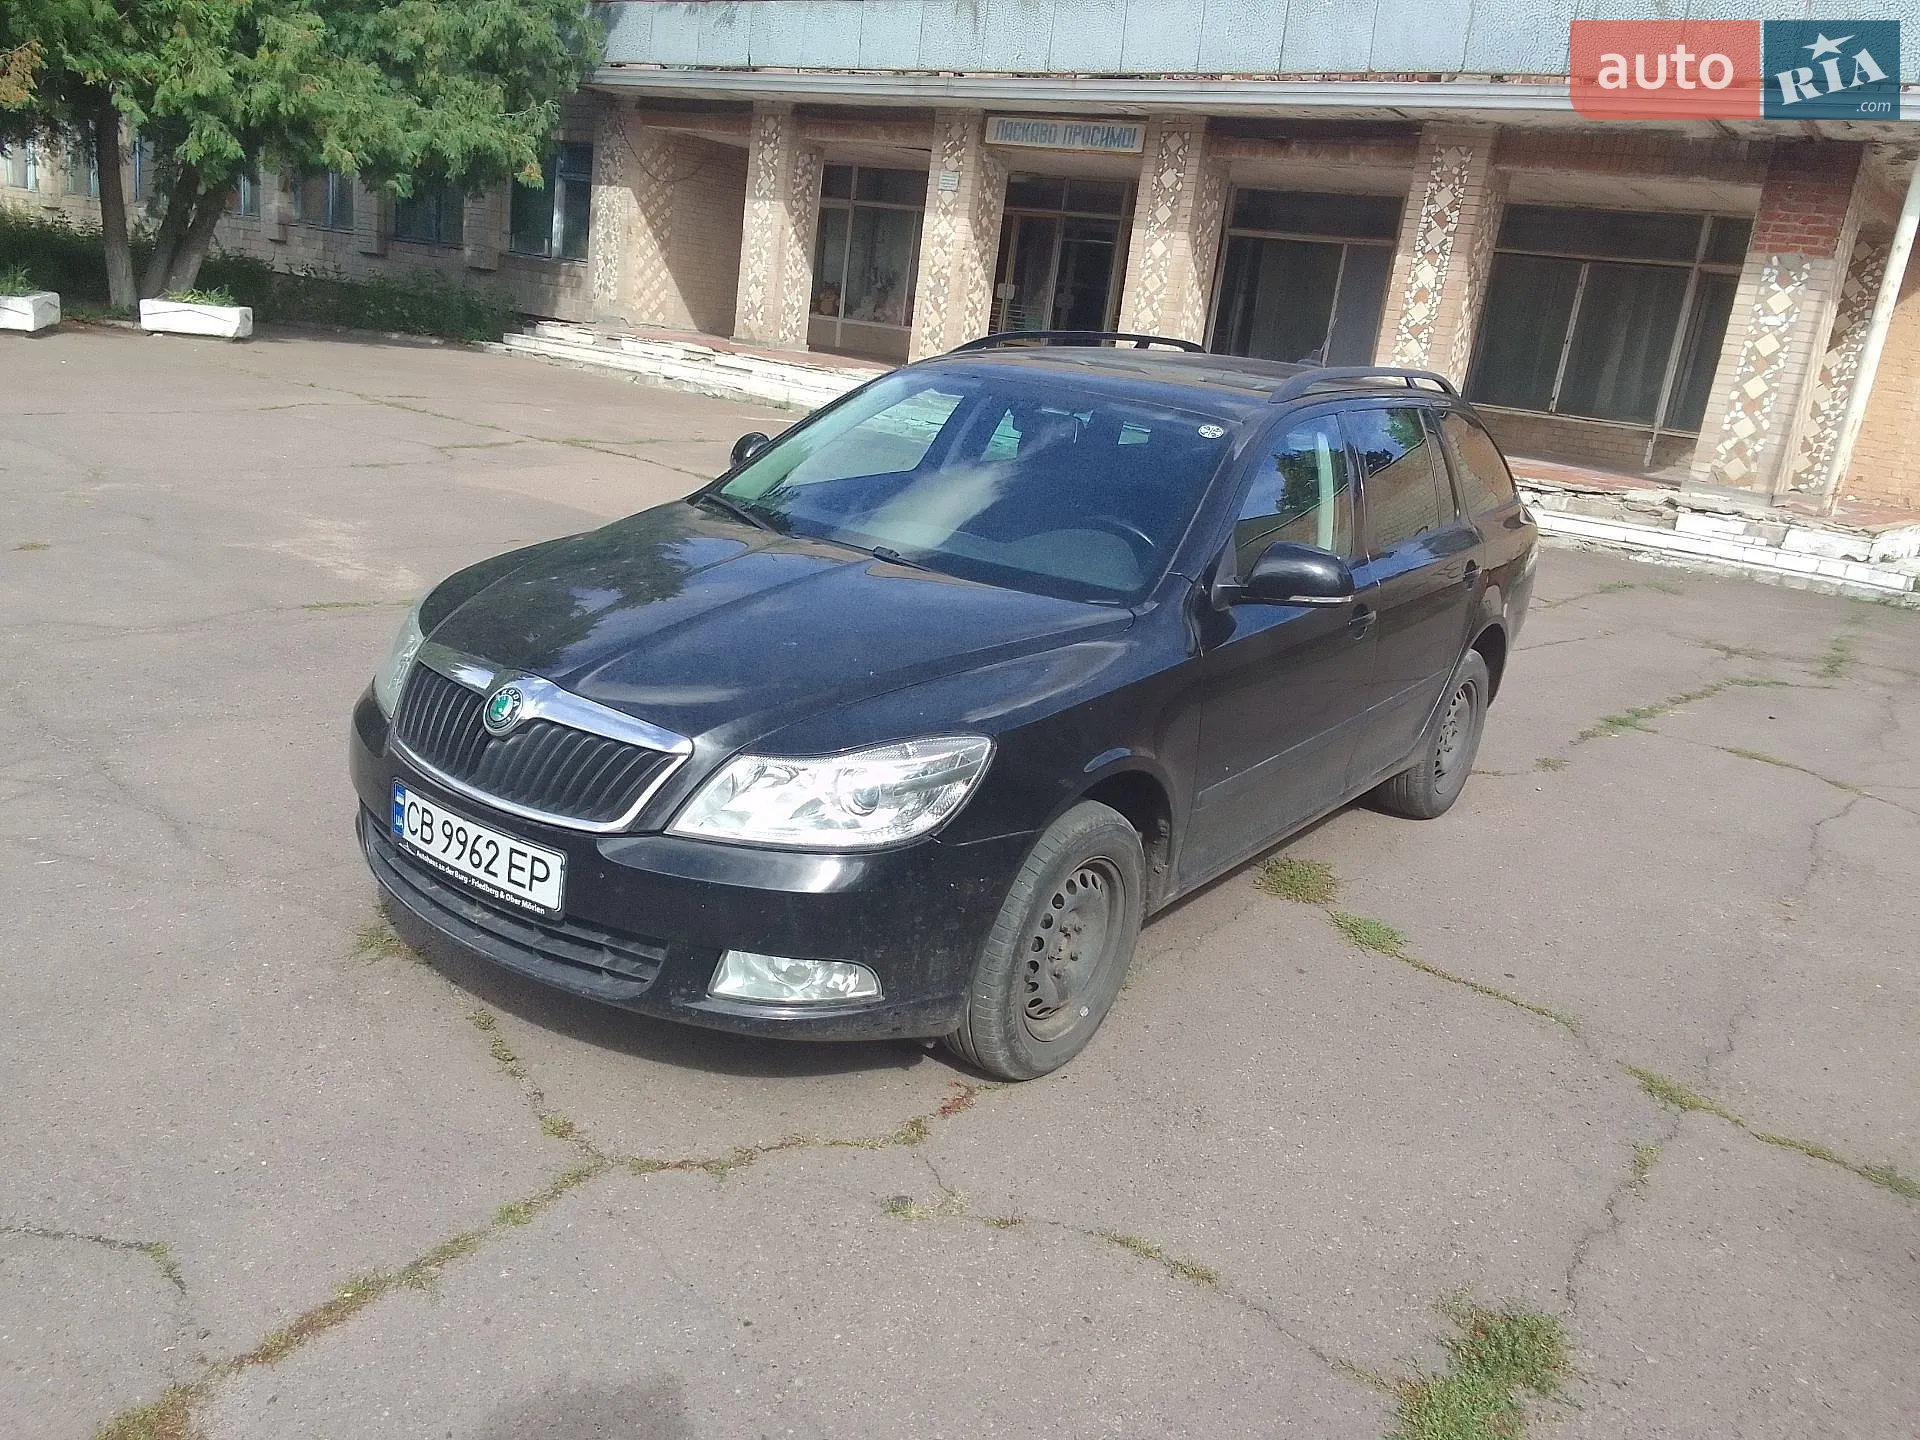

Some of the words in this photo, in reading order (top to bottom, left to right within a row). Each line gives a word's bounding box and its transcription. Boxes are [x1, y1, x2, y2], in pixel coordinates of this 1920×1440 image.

[993, 119, 1058, 145] ЛАСКАВО
[1062, 124, 1137, 149] ПРОСИМО!
[406, 801, 434, 845] CB
[441, 820, 500, 878] 9962
[507, 847, 550, 892] EP
[445, 866, 455, 876] der
[454, 870, 469, 884] Burg
[471, 878, 500, 899] Friedberg
[505, 893, 522, 906] Ober
